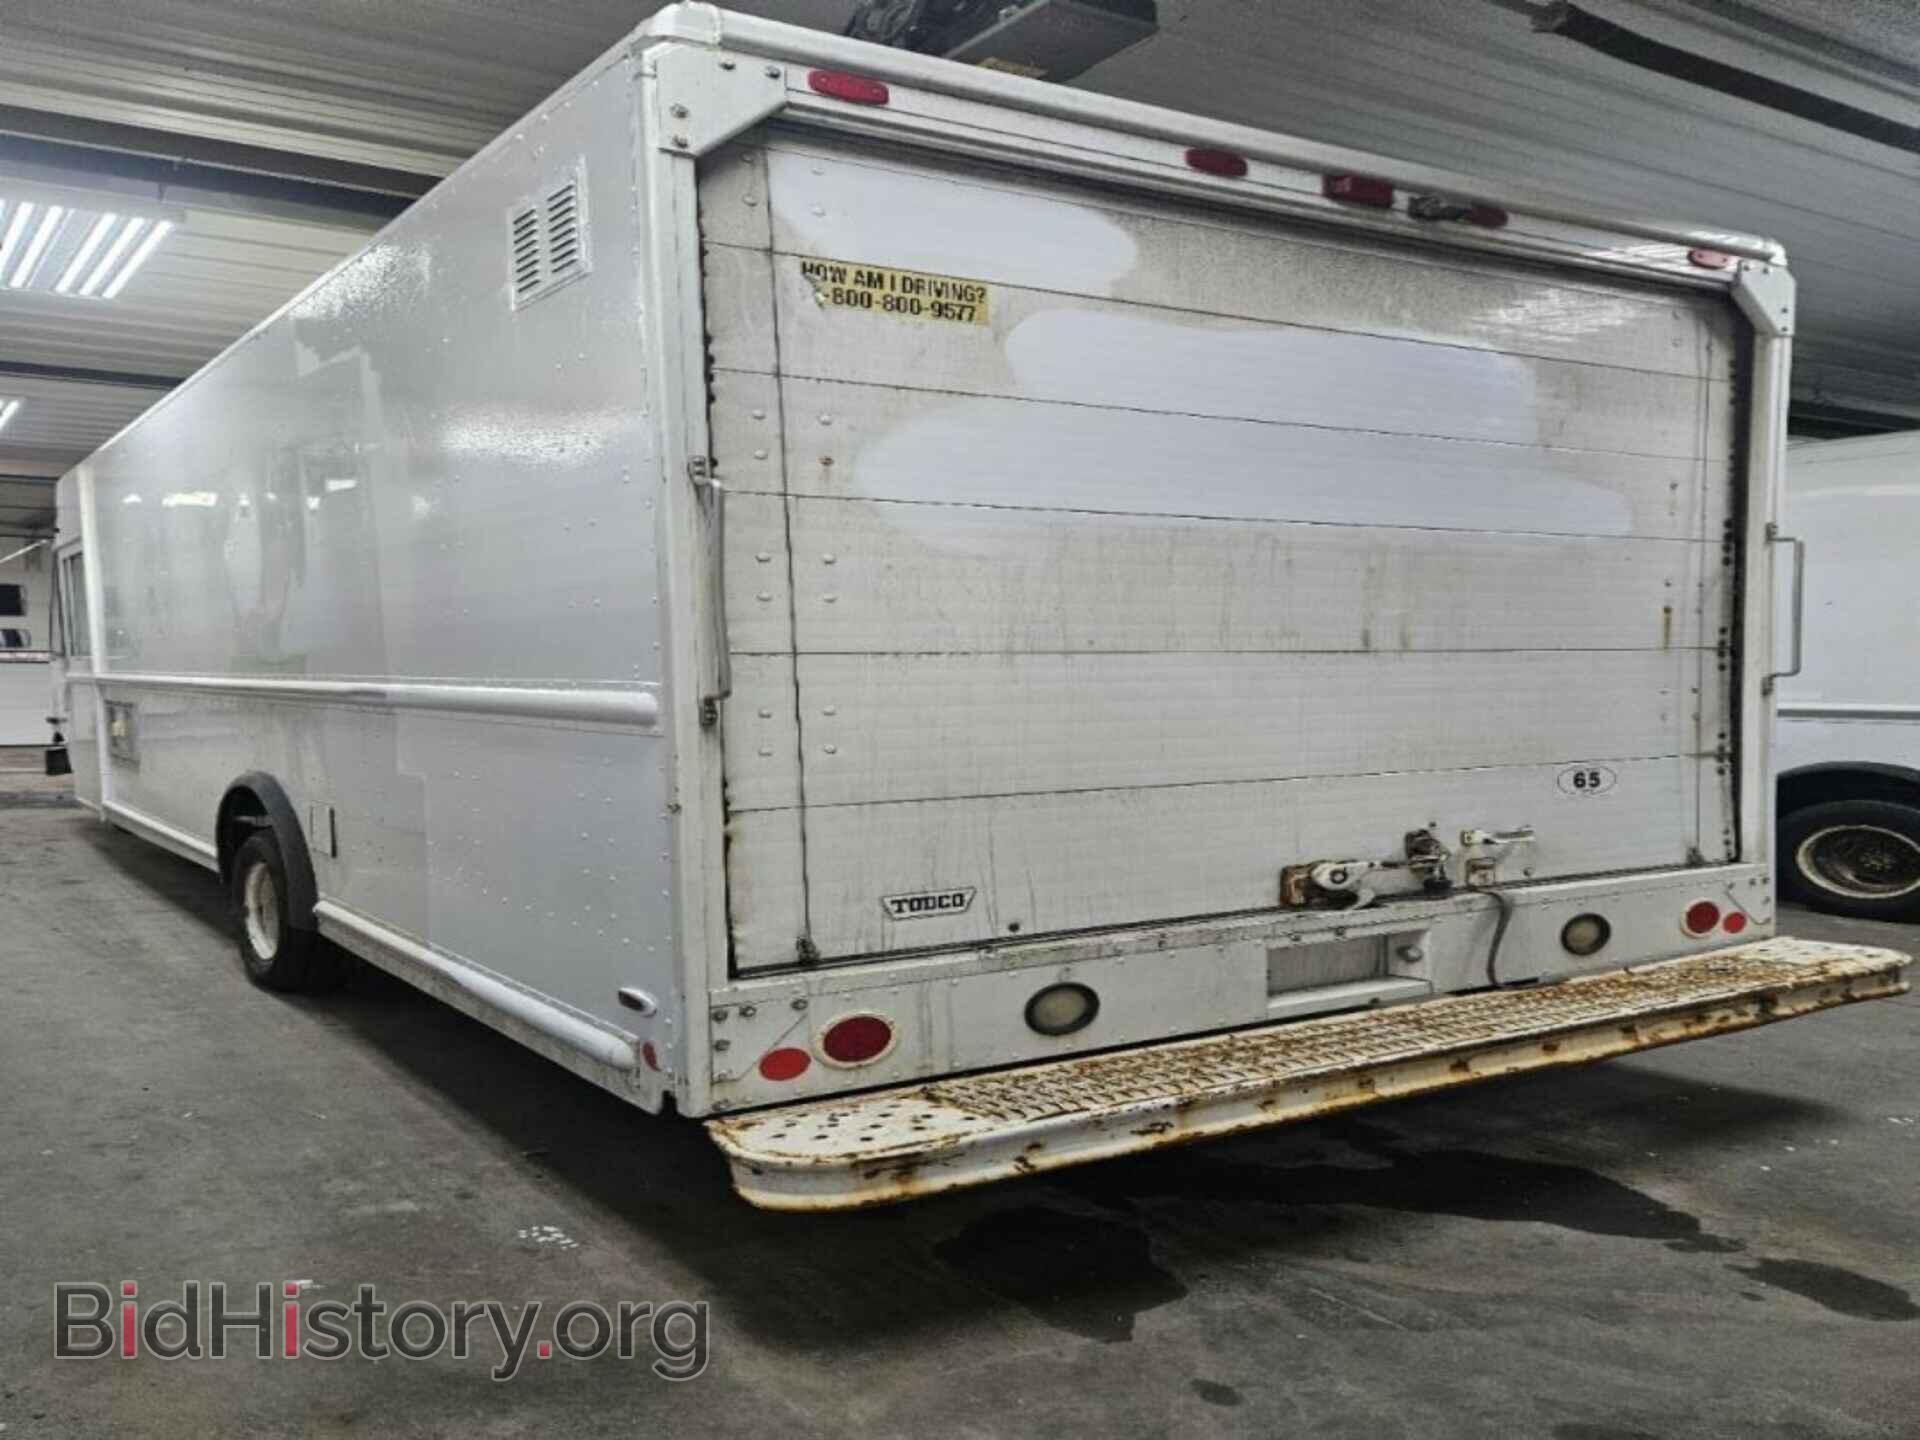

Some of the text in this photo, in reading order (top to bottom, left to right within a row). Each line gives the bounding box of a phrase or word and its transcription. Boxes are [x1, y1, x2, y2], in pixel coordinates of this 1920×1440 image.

[801, 260, 987, 303] HOW AM I DRIVING?
[823, 286, 977, 323] -800-800-9577
[1573, 771, 1601, 788] 65
[890, 893, 964, 913] TODCO
